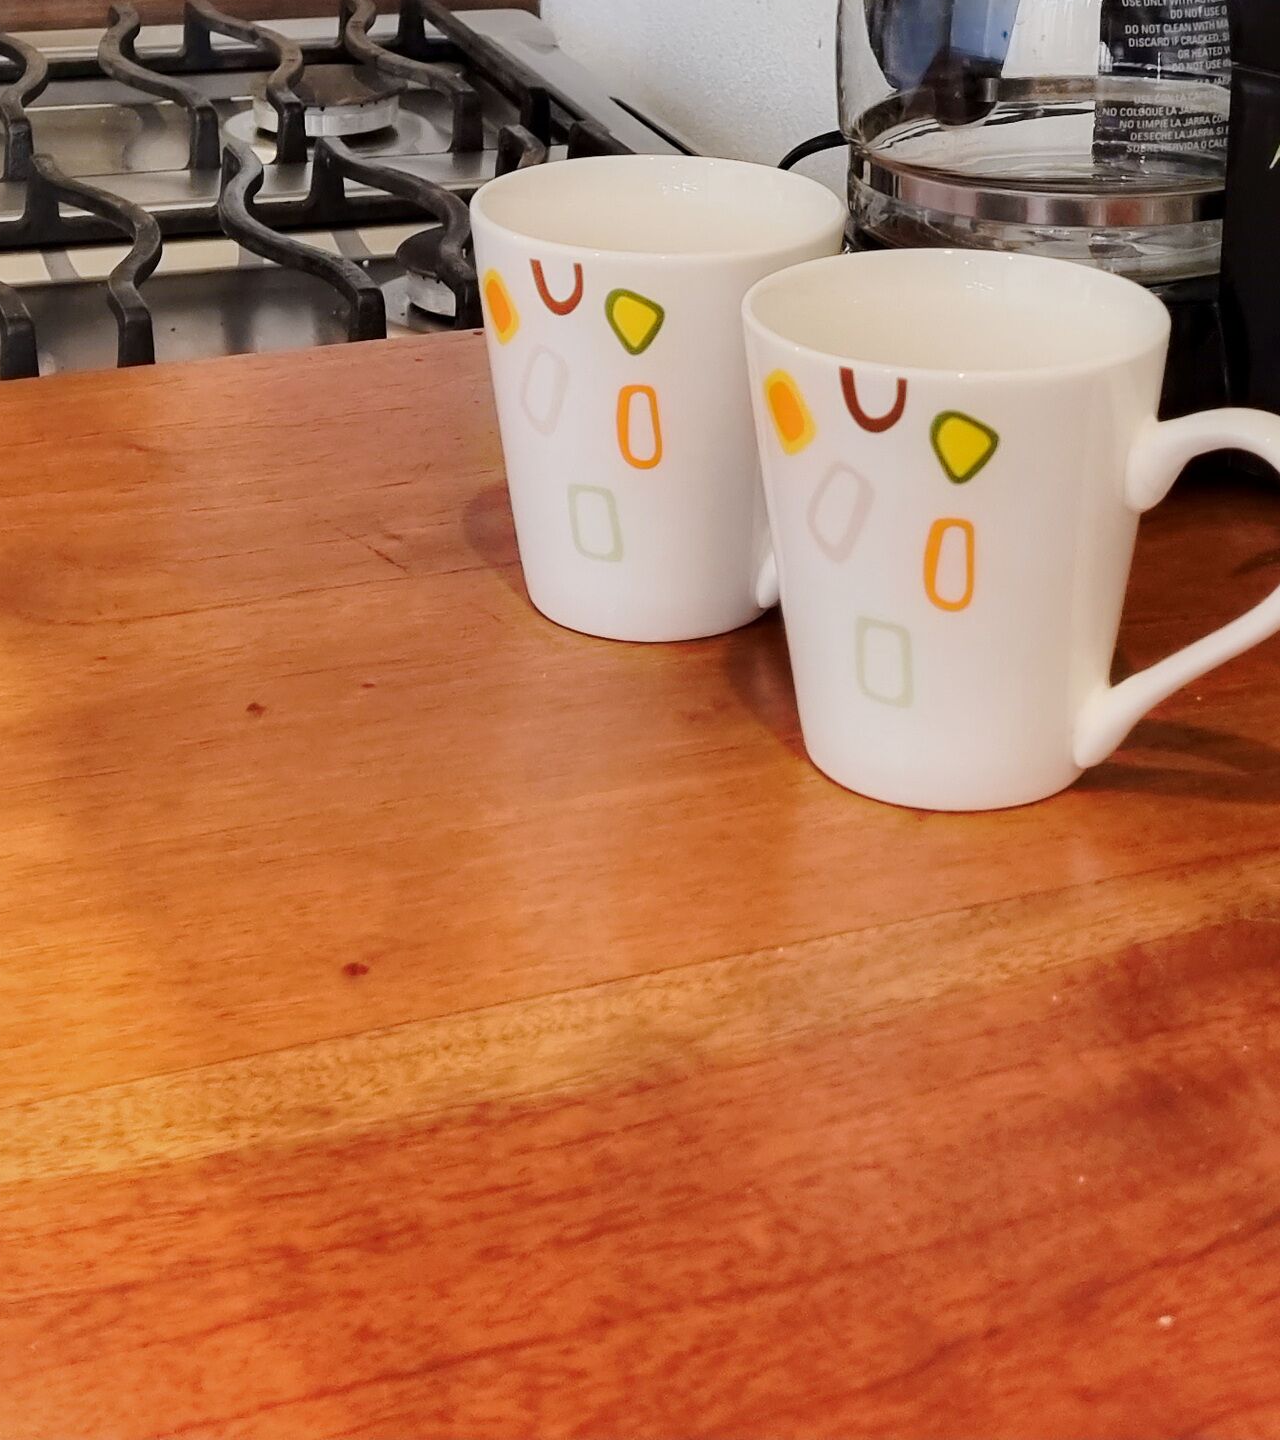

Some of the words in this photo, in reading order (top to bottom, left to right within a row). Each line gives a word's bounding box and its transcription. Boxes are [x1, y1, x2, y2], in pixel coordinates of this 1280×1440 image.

[1170, 8, 1183, 20] DO
[1185, 5, 1202, 18] NOT
[1204, 5, 1220, 17] USE
[1125, 24, 1139, 35] DO
[1141, 23, 1161, 35] NOT
[1163, 22, 1191, 34] CLEAN
[1192, 20, 1216, 32] WITH
[1128, 35, 1170, 48] DISCARD
[1177, 48, 1190, 60] OR
[1191, 45, 1223, 58] HEATED
[1205, 58, 1221, 70] USE
[1102, 107, 1118, 117] NO
[1166, 105, 1177, 116] LA
[1119, 119, 1135, 130] NO
[1137, 117, 1169, 129] LIMPIE
[1170, 117, 1182, 128] LA
[1183, 115, 1210, 128] JARRA
[1130, 130, 1173, 142] DESECHE
[1174, 129, 1186, 141] LA
[1187, 127, 1214, 140] JARRA
